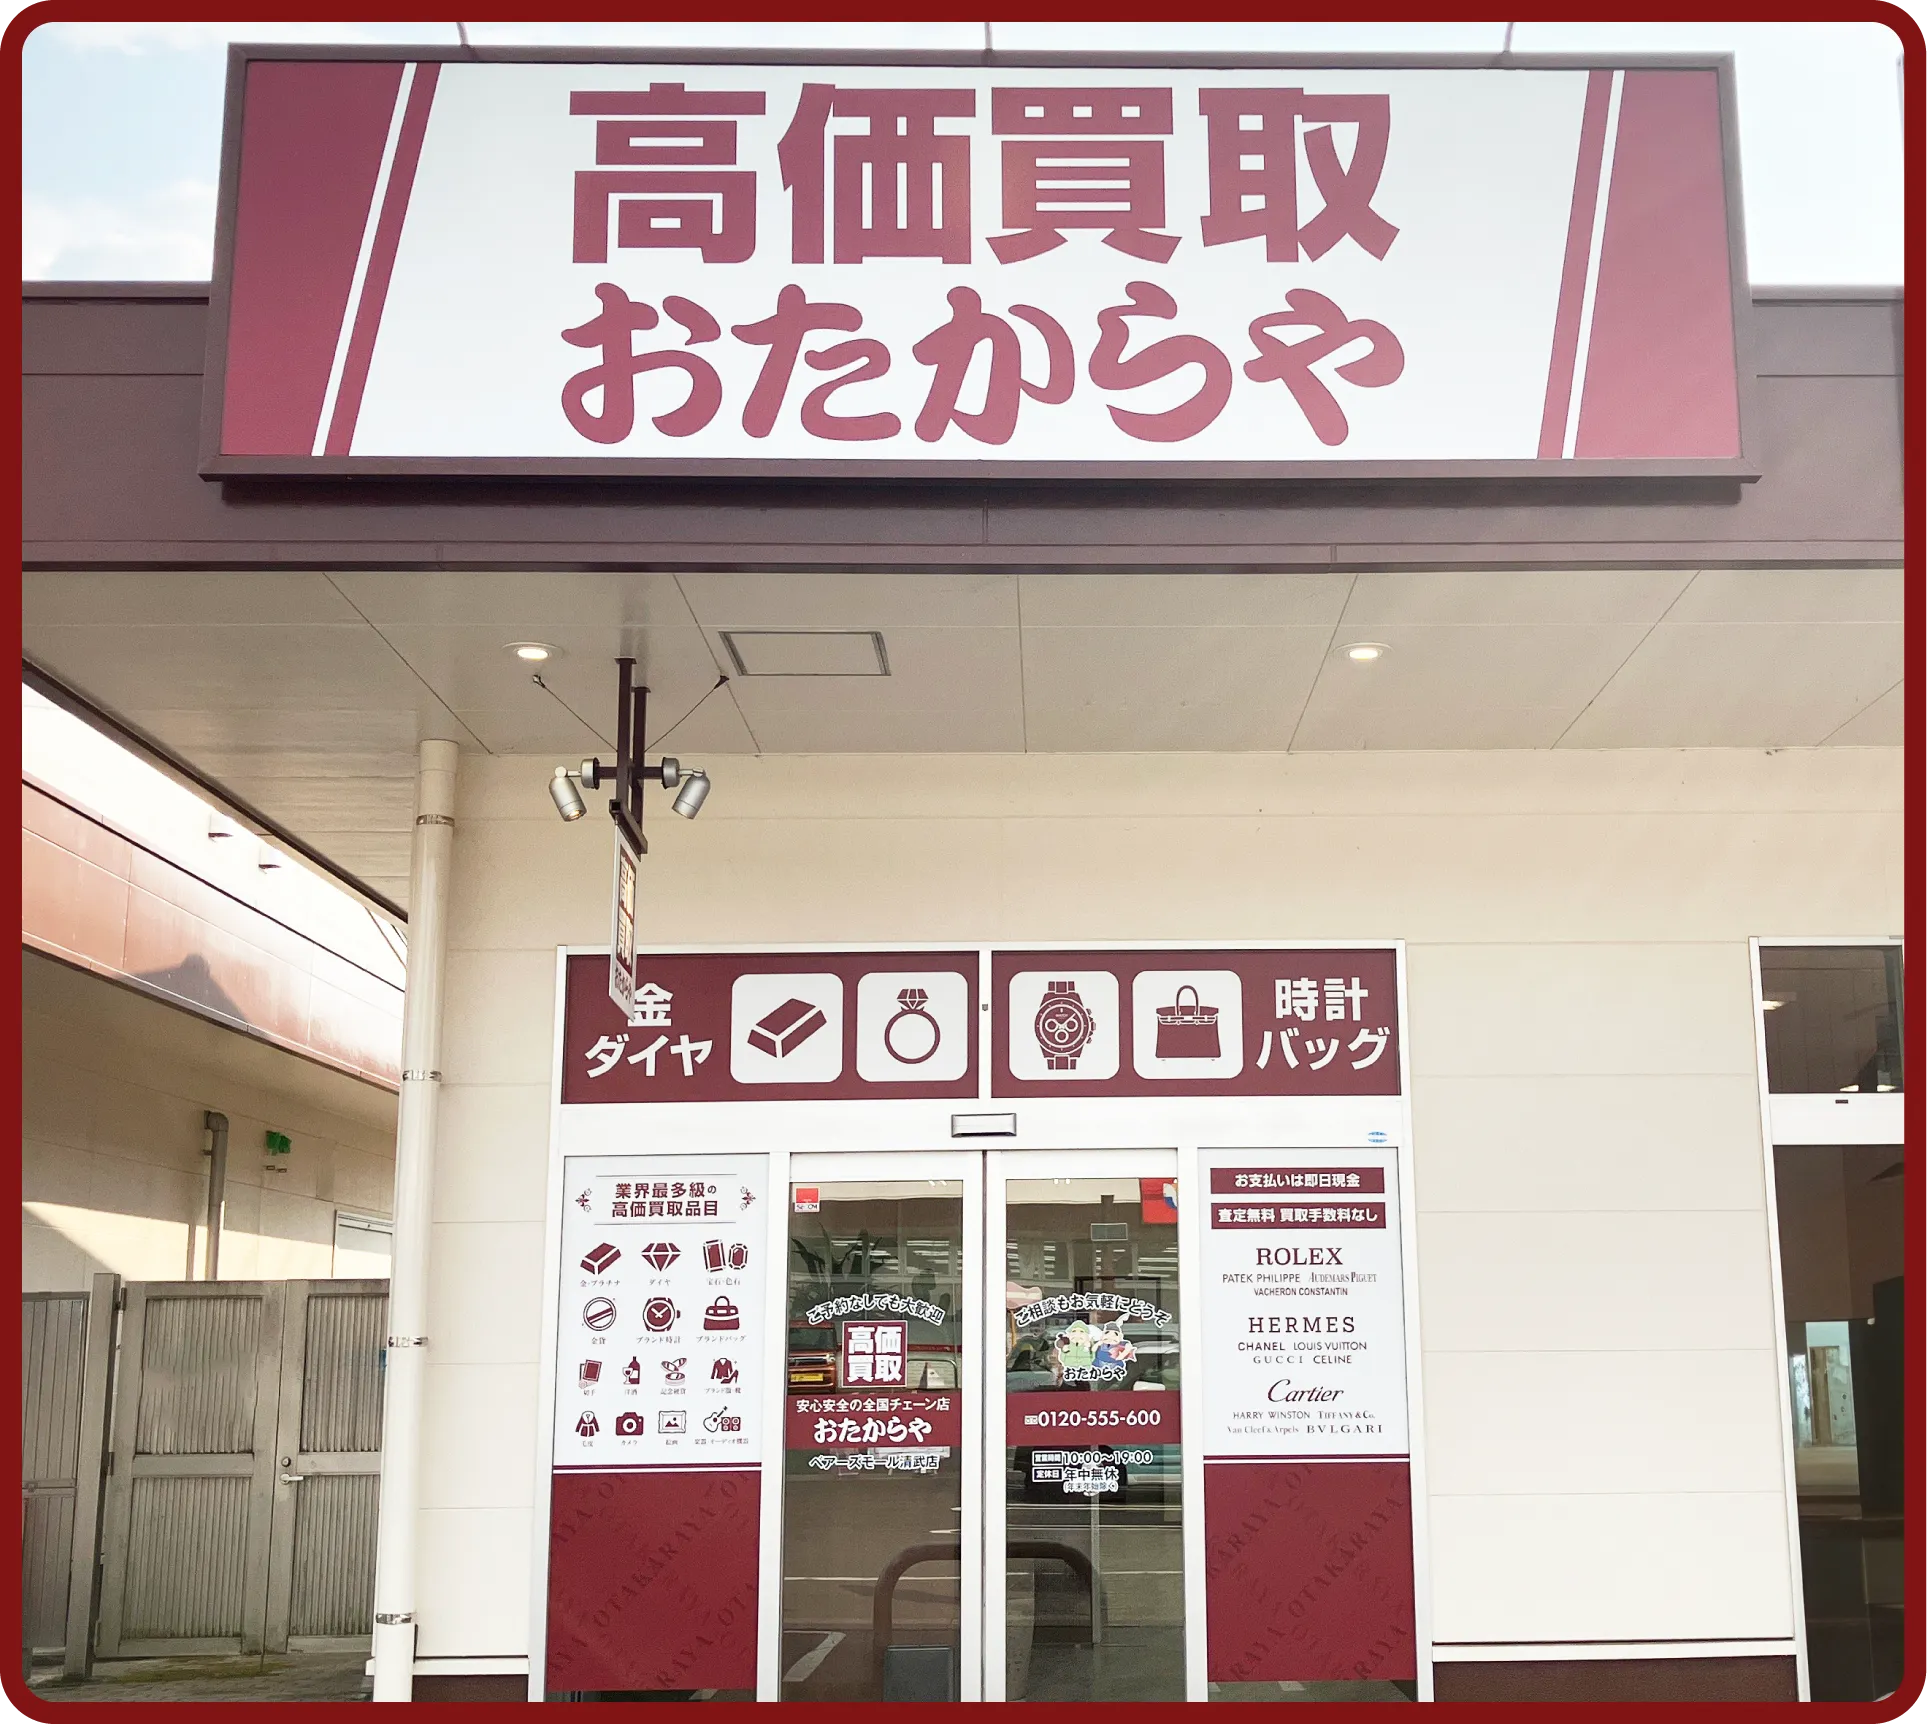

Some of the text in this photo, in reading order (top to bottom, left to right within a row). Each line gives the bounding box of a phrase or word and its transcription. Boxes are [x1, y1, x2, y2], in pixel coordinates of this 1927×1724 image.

[568, 82, 1400, 266] 高価買取
[560, 281, 1406, 447] おたからや
[627, 982, 674, 1027] 金
[1274, 976, 1369, 1022] 時計
[584, 1033, 714, 1079] ダイヤ
[1255, 1026, 1391, 1071] バッグ
[1234, 1173, 1361, 1188] お支払いは即日現金
[614, 1181, 717, 1199] 業界最多級の
[612, 1200, 719, 1218] 高価買取品目
[1218, 1207, 1378, 1223] 査定無料 買取手数料なし
[1255, 1247, 1344, 1266] ROLEX
[649, 1278, 671, 1286] ダイヤ
[1222, 1273, 1300, 1283] PATEK PHILIPPE
[1309, 1271, 1377, 1283] AUDEMARS PIGUET
[1254, 1287, 1348, 1296] VACHERON CONSTANTIN
[807, 1294, 944, 1326] ご予約なしでも大歓迎
[1015, 1293, 1171, 1327] ご相談もお気軽にどうぞ
[1248, 1316, 1356, 1333] HERMES
[696, 1334, 747, 1343] ブランドバッグ
[847, 1326, 902, 1354] 高価
[1237, 1342, 1286, 1351] CHANEL
[1293, 1341, 1367, 1350] LOUIS VUITTON
[1253, 1355, 1303, 1364] GUCCI
[1313, 1355, 1352, 1364] CELINE
[847, 1355, 902, 1383] 買取
[1064, 1367, 1126, 1381] おたからや
[1267, 1378, 1345, 1403] Cartier
[796, 1398, 951, 1413] 安心安全の全国チェーン店
[1038, 1410, 1161, 1427] 0120-555-600
[1233, 1411, 1311, 1420] HARRY WINSTON
[813, 1415, 933, 1444] おたからや
[1306, 1424, 1383, 1434] BVLGARI
[809, 1454, 939, 1469] ベアーズモール清武店
[1036, 1466, 1119, 1481] 定休日 年中無休
